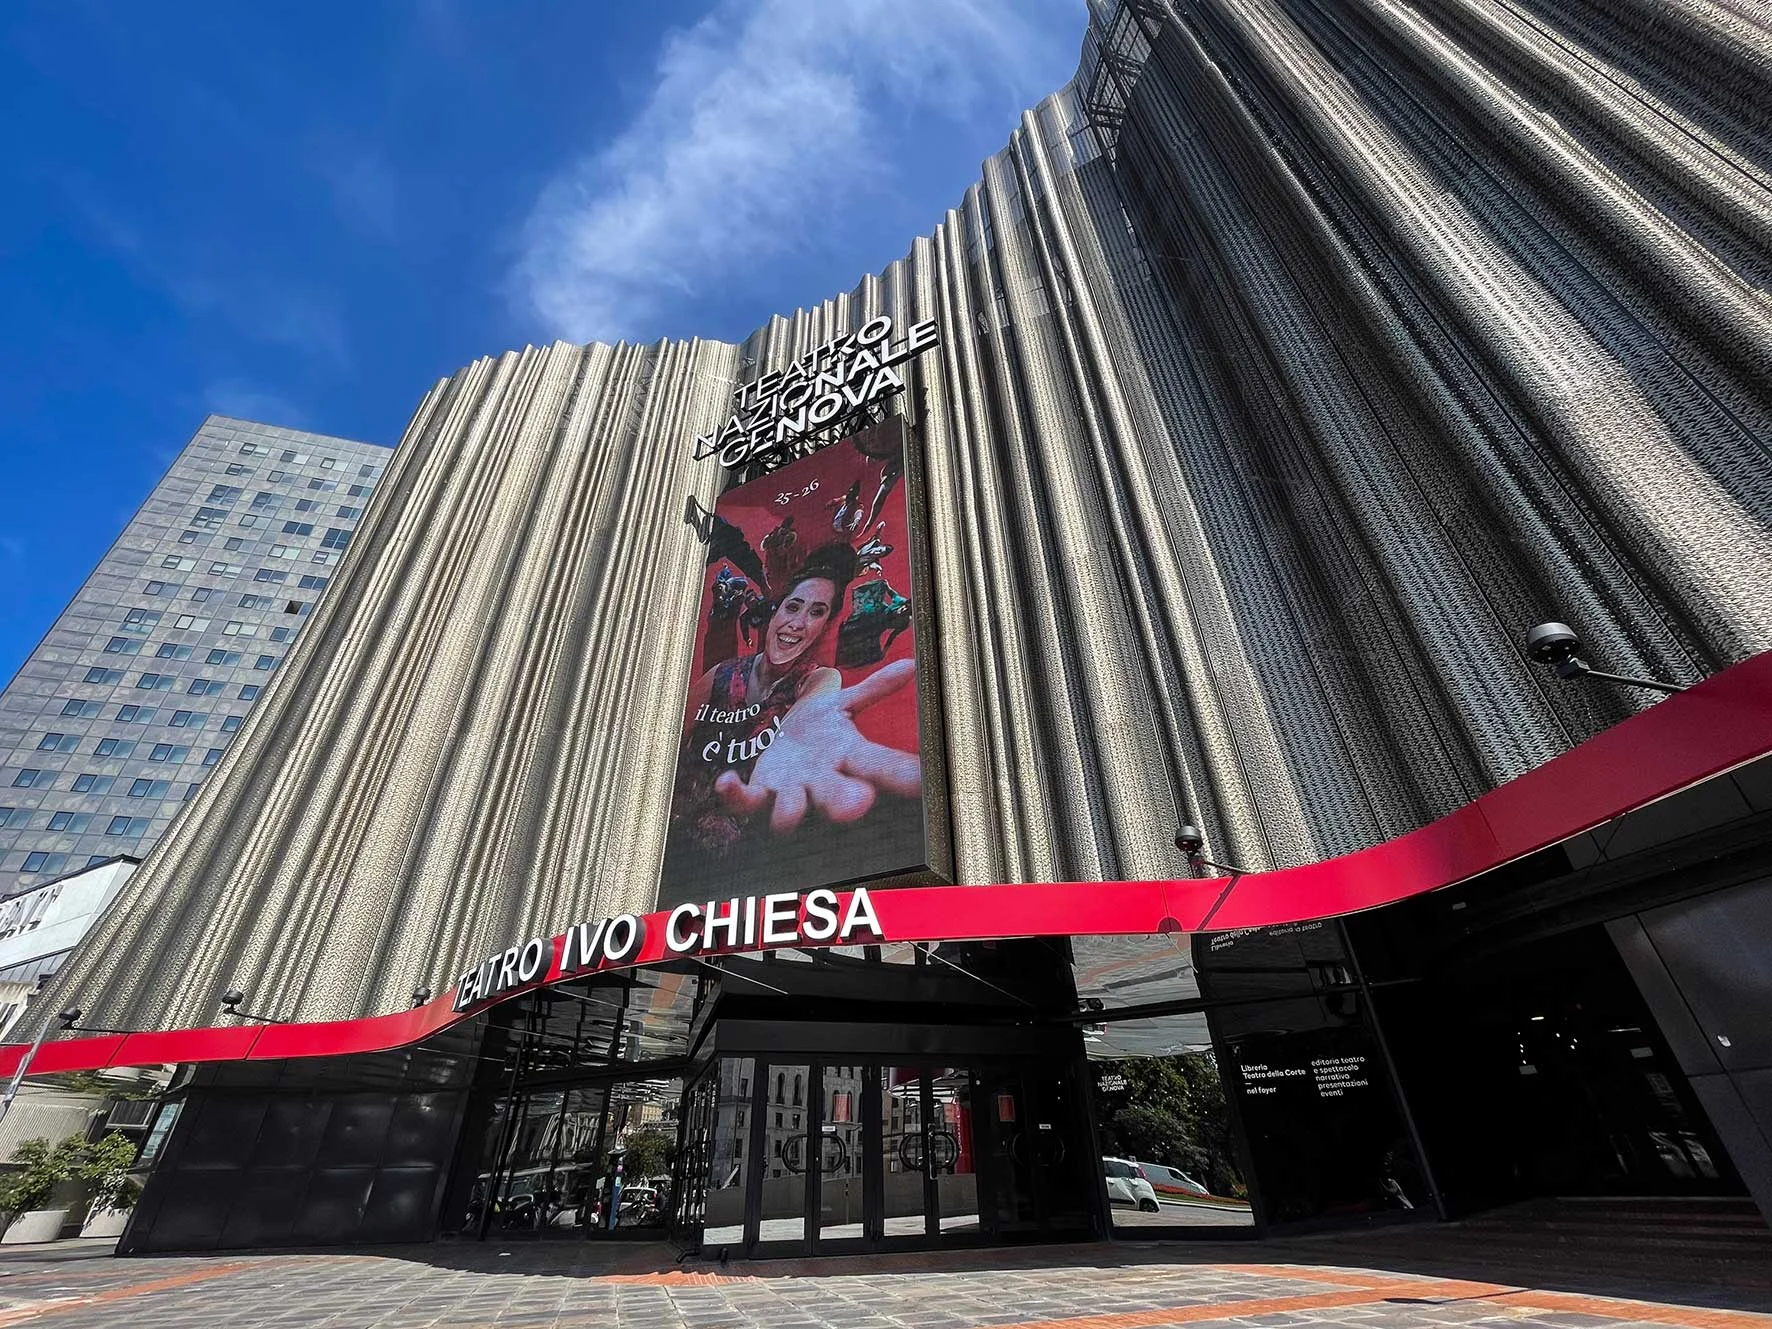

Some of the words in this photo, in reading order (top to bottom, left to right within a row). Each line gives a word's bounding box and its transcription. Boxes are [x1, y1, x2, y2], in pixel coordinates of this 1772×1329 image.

[734, 315, 893, 409] TEATRO
[693, 316, 938, 459] NAZIONALE
[718, 365, 905, 468] GENOVA
[694, 703, 710, 722] il
[709, 703, 761, 724] teatro
[727, 715, 785, 764] tuo!
[452, 937, 544, 1012] TEATRO
[559, 914, 639, 972] IVO
[665, 887, 884, 953] CHIESA
[1240, 1063, 1269, 1072] Libreria
[1311, 1057, 1340, 1067] editoria
[1340, 1056, 1366, 1065] teatro
[1242, 1072, 1266, 1080] Teatro
[1266, 1069, 1284, 1078] della
[1284, 1068, 1306, 1077] Corte
[1319, 1064, 1360, 1075] spettacolo
[1315, 1073, 1350, 1082] narrativa
[1317, 1078, 1369, 1090] presentazioni
[1246, 1086, 1258, 1095] nel
[1257, 1086, 1277, 1095] foyer
[1320, 1088, 1344, 1098] eventi
